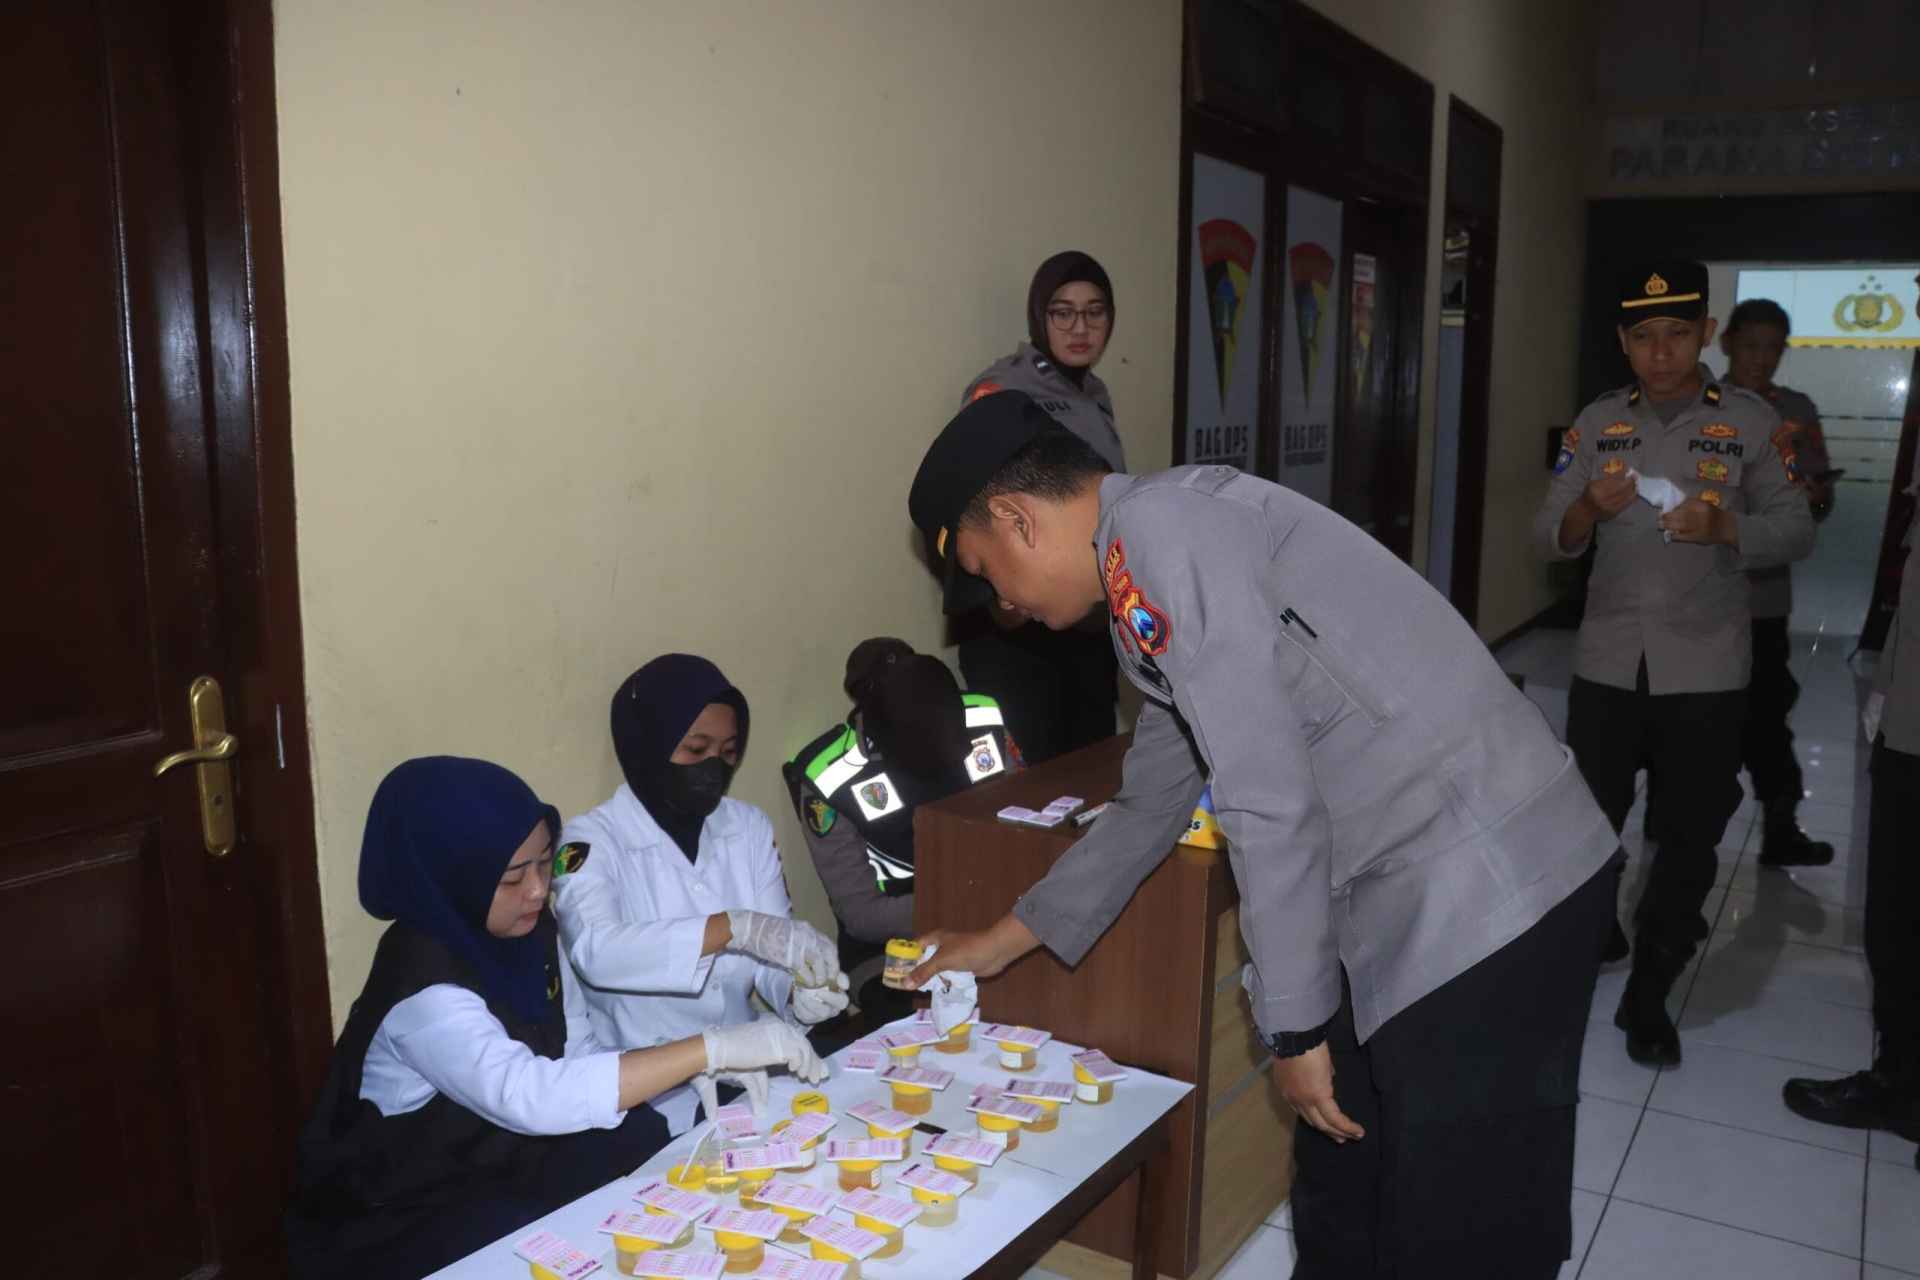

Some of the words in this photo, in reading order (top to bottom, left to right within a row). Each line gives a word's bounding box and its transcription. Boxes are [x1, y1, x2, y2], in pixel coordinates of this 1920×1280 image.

[1195, 428, 1221, 458] BAG
[1224, 425, 1248, 454] OPS
[1285, 426, 1306, 451] BAG
[1308, 424, 1328, 449] OPS
[1596, 437, 1641, 453] WIDY.P
[1688, 439, 1744, 458] POLRI
